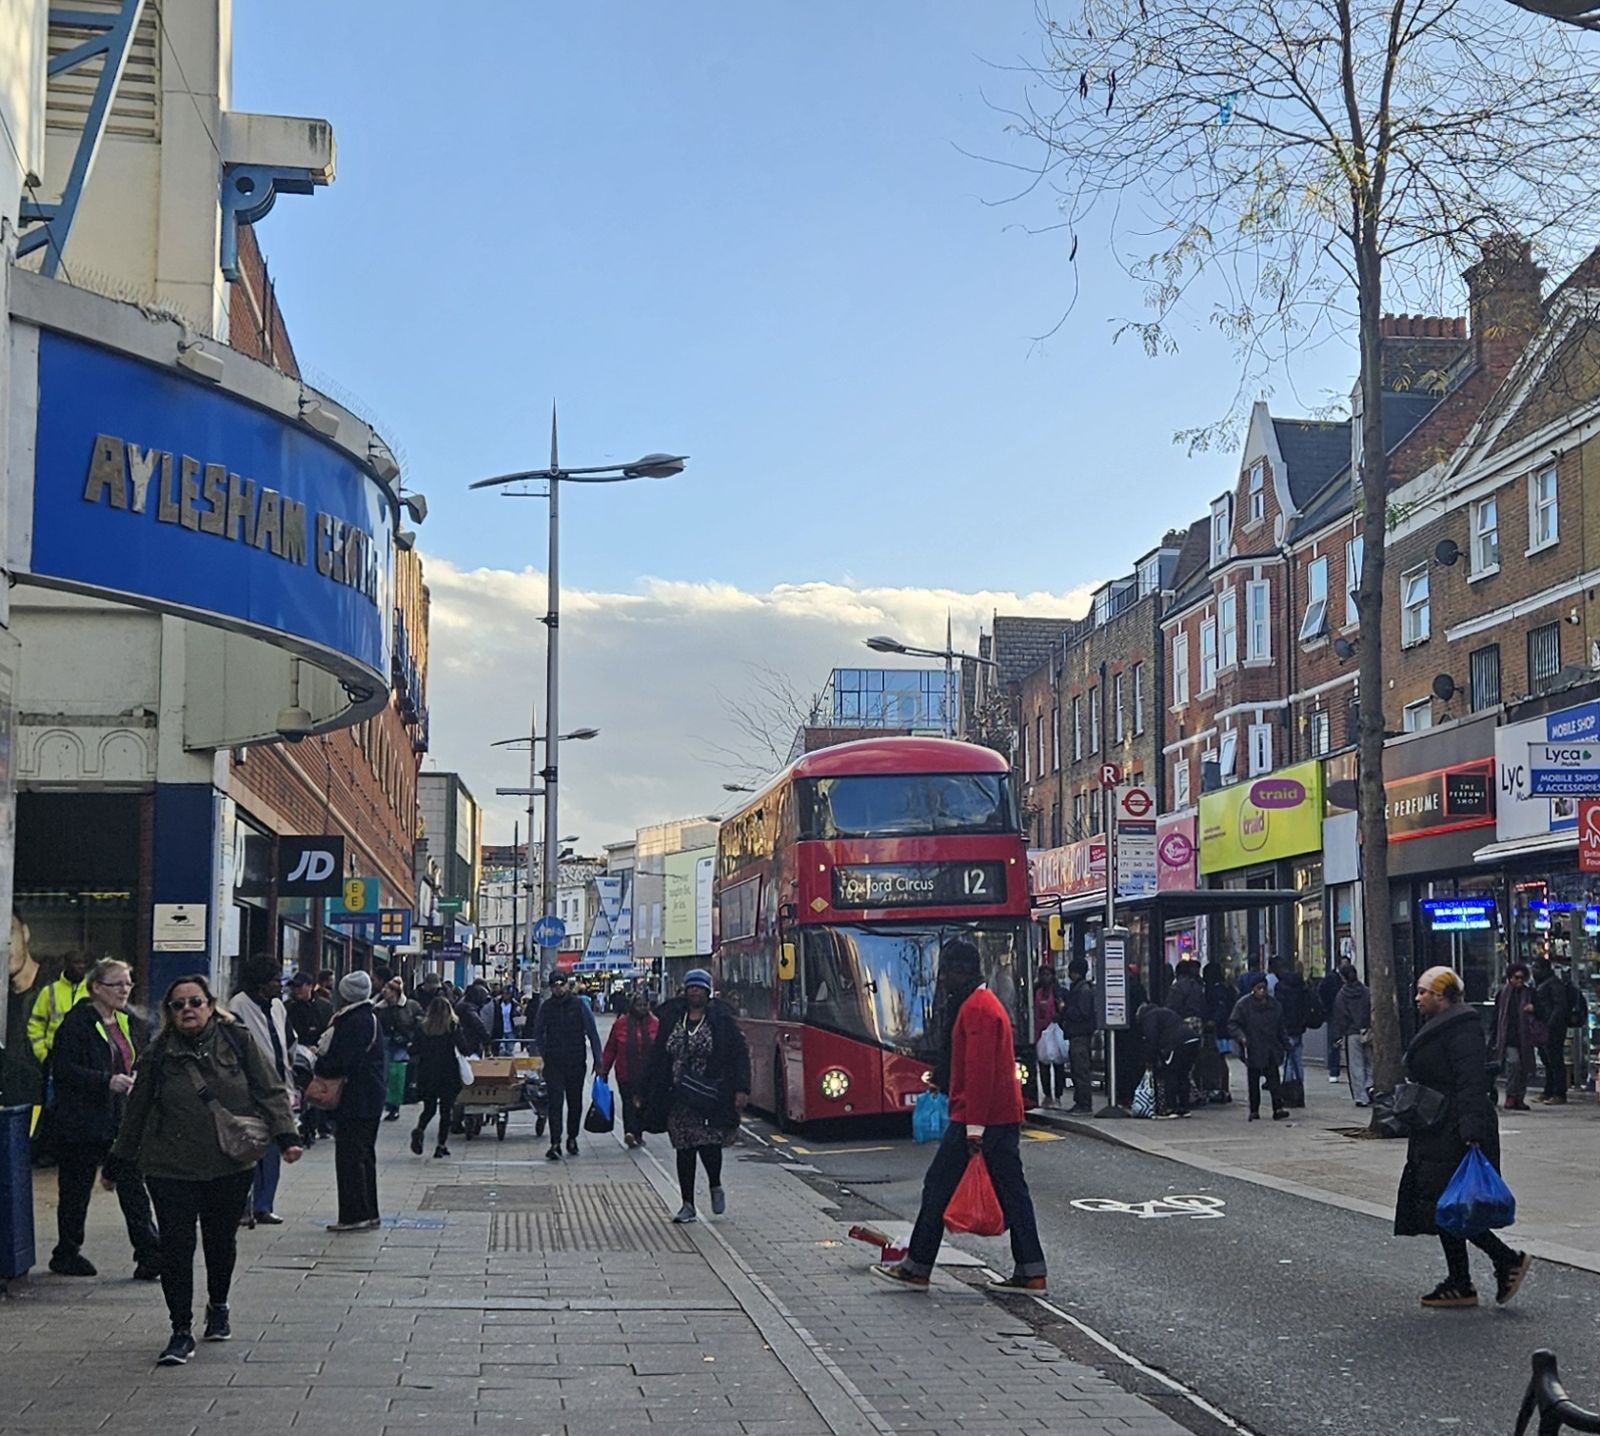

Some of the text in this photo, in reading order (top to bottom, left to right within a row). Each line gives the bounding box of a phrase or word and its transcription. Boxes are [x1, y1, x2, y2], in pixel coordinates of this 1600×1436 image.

[84, 433, 380, 607] AYLESHAM CENTR
[1551, 719, 1576, 739] MOBILE
[1576, 715, 1595, 732] SHOP
[1545, 747, 1580, 763] Lyca
[1103, 766, 1116, 782] R
[1502, 764, 1524, 795] Lyc
[1540, 774, 1599, 782] MOBILE SHOP
[1259, 787, 1297, 800] traid
[1394, 793, 1439, 817] PERFUME
[287, 850, 335, 882] JD
[895, 878, 934, 891] Circus
[963, 869, 987, 895] 12
